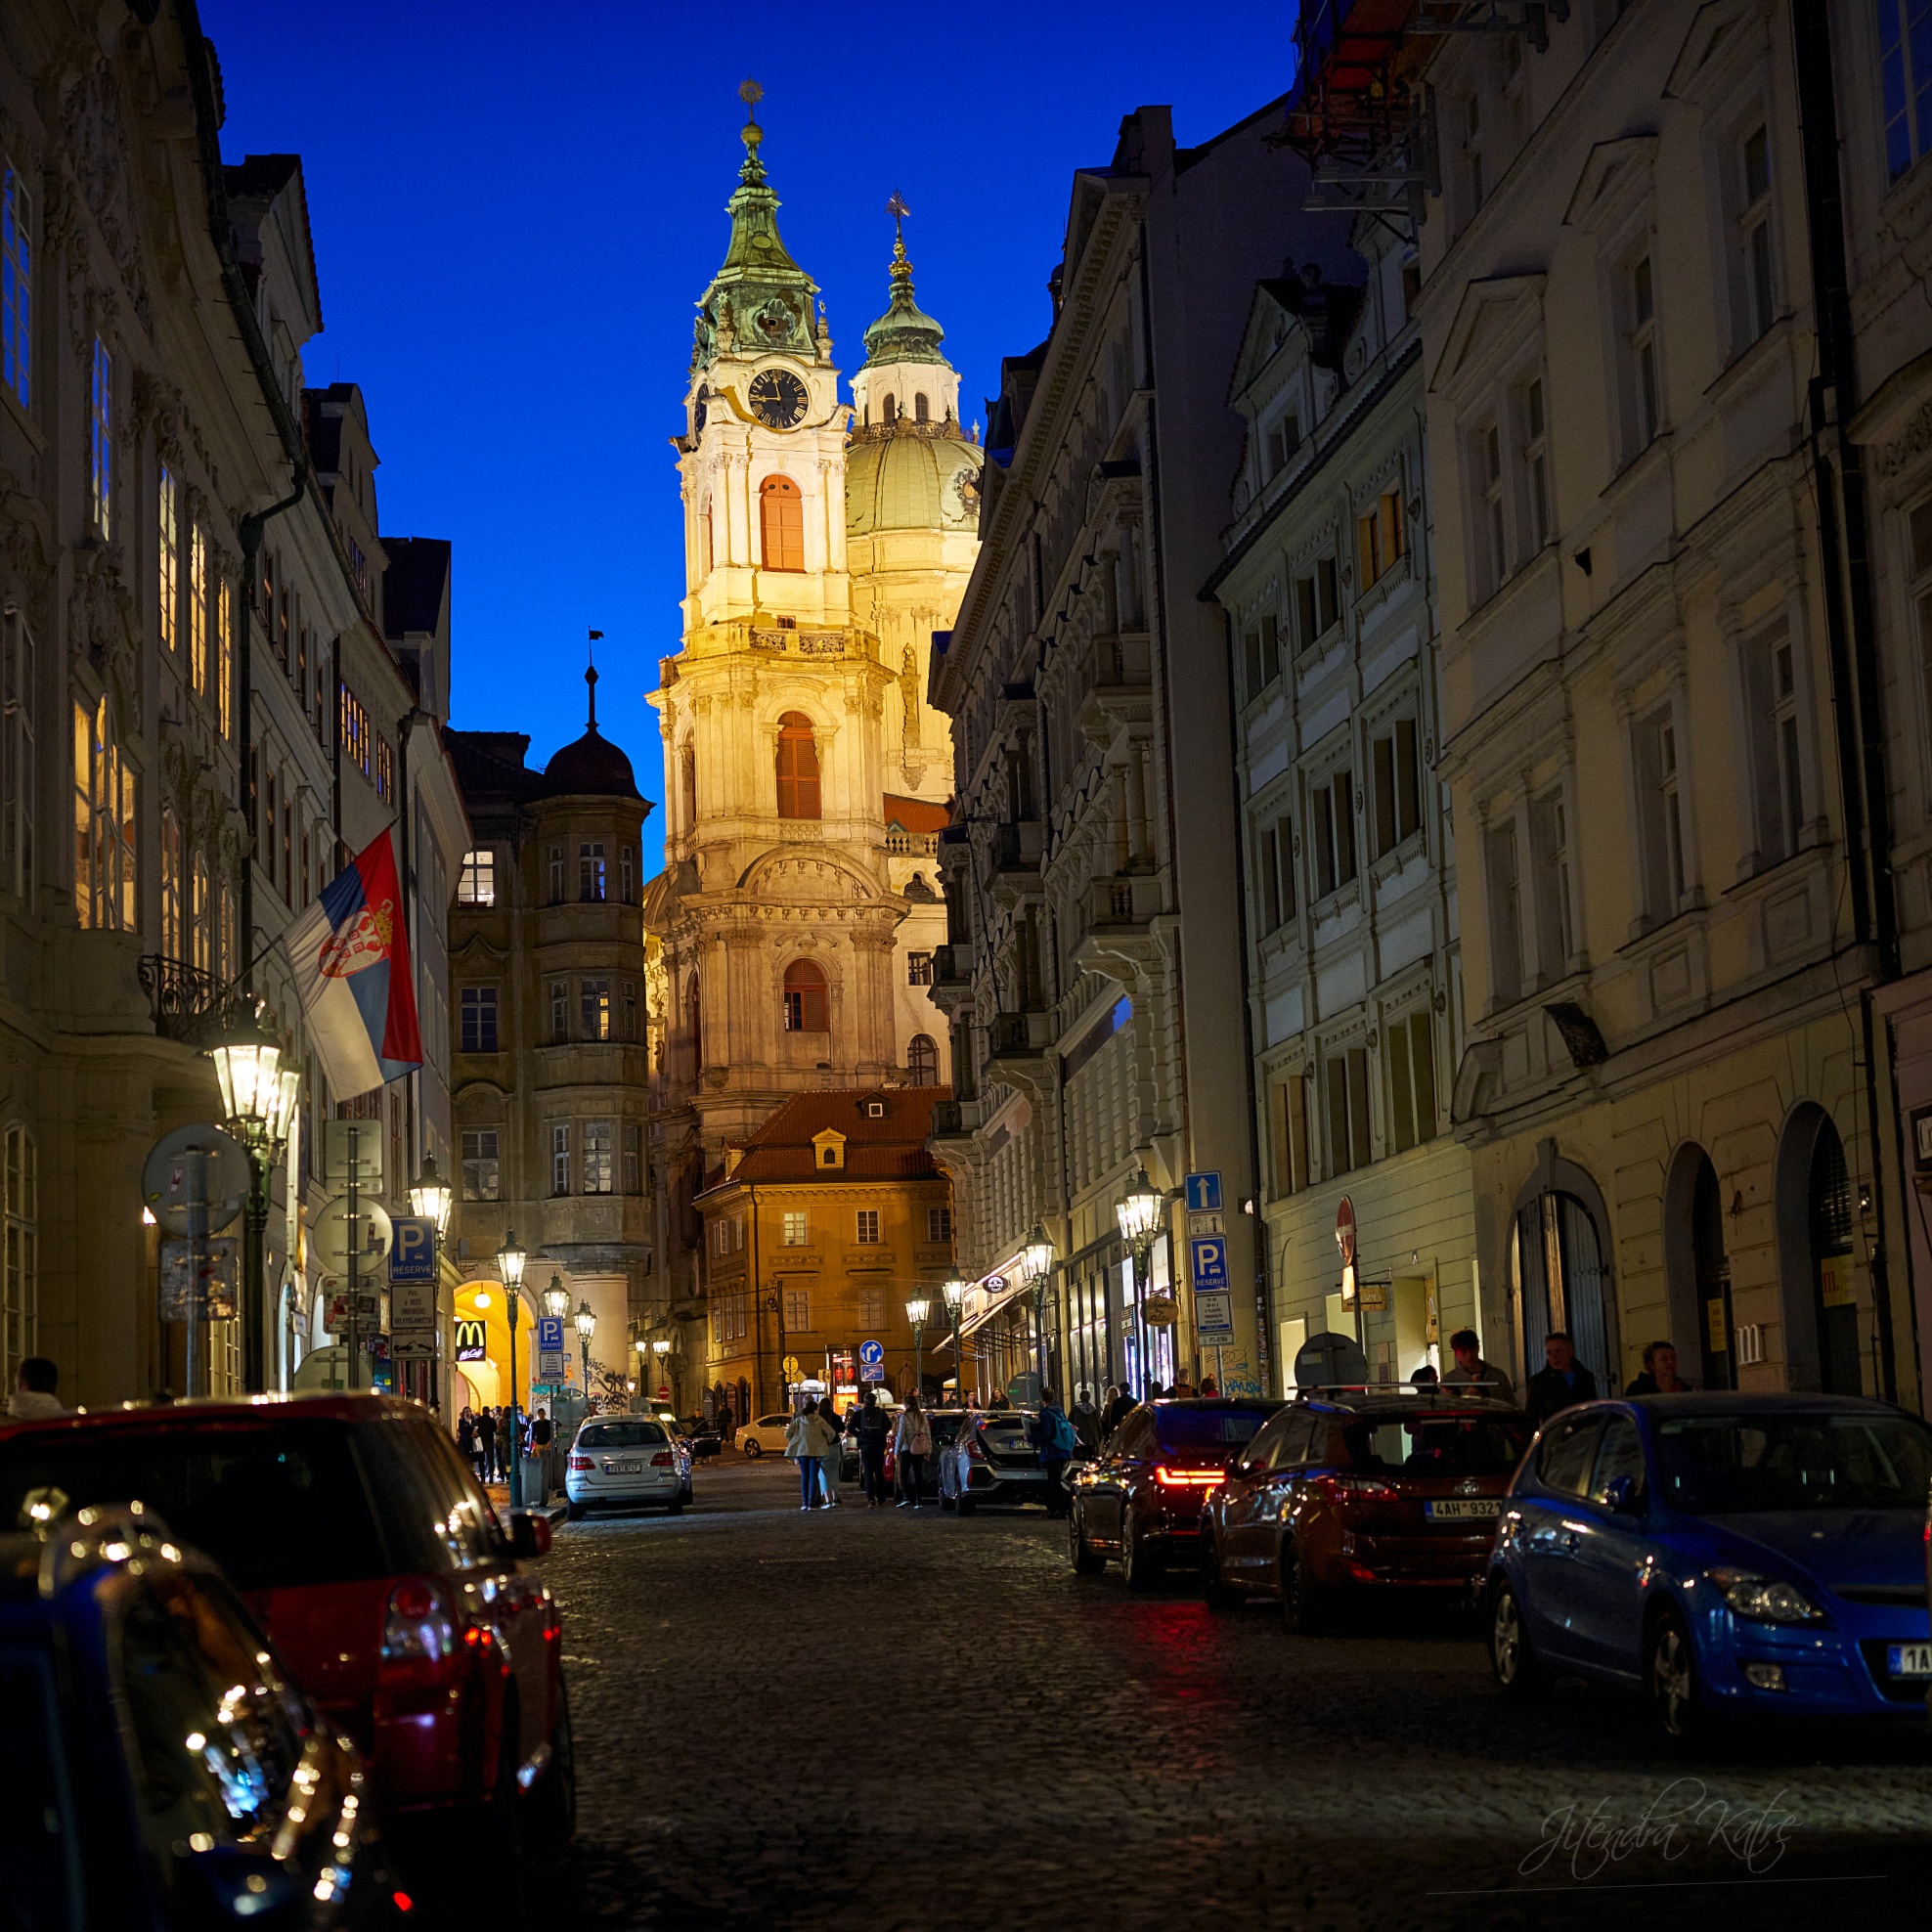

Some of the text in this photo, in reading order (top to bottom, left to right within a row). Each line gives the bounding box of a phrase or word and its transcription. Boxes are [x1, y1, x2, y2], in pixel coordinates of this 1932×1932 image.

[399, 1225, 424, 1261] P
[1198, 1245, 1219, 1276] P
[544, 1322, 557, 1341] P
[1436, 1502, 1461, 1515] 4AH
